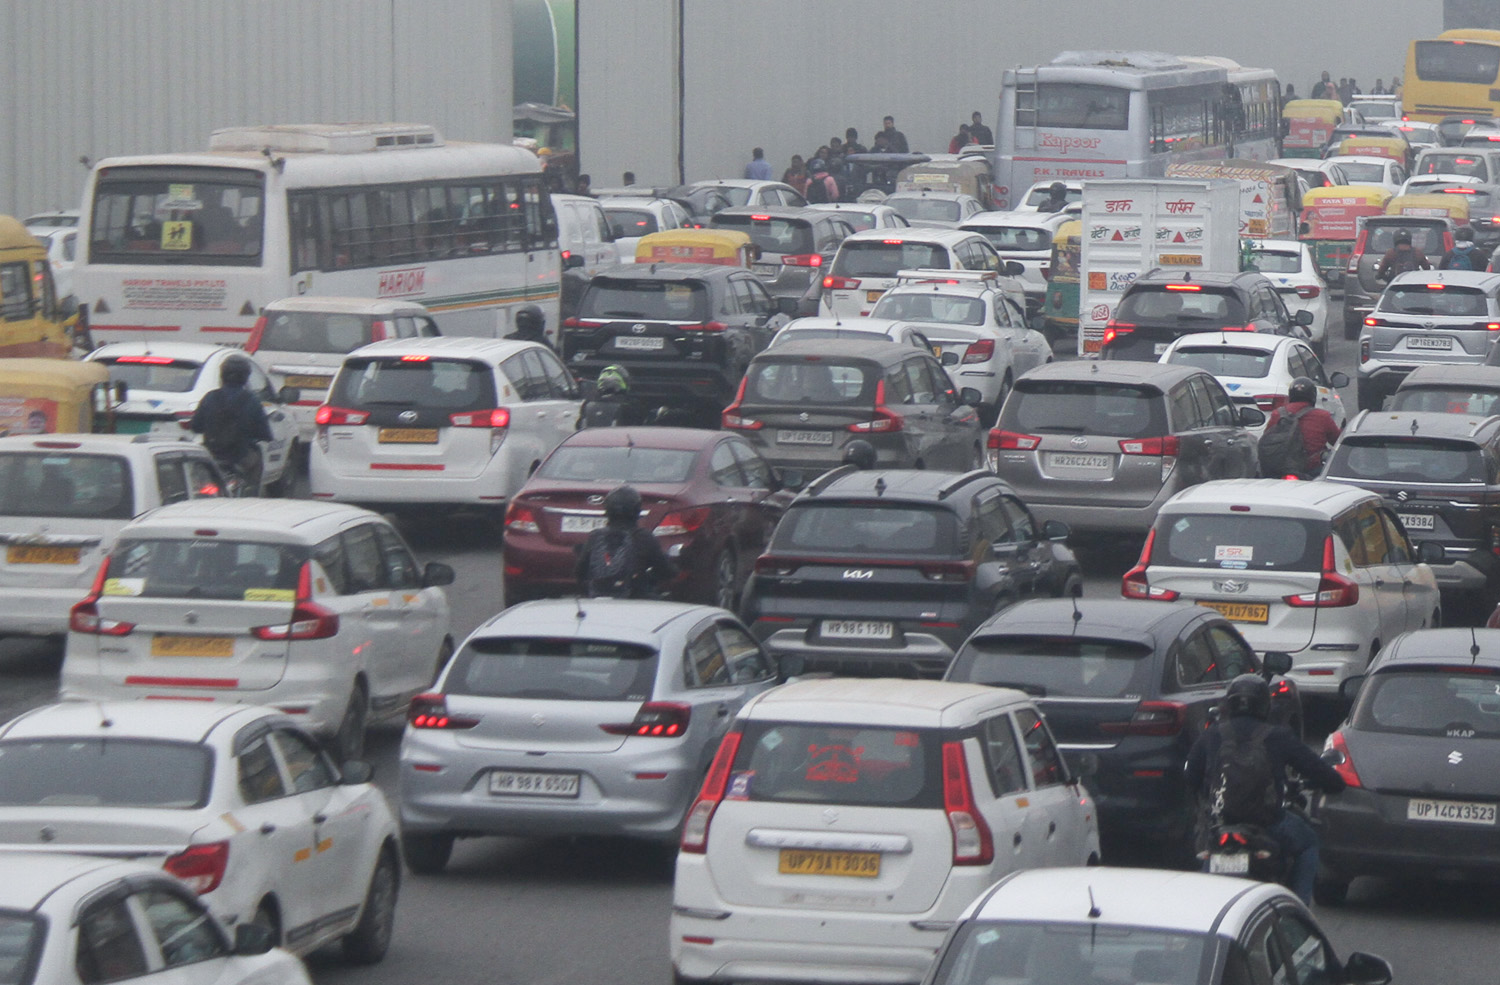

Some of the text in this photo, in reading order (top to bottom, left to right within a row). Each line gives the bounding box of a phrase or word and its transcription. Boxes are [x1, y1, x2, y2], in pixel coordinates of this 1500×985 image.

[1039, 132, 1102, 154] Kapoor
[1056, 168, 1105, 177] TRAVELS
[1104, 199, 1134, 213] डाक
[155, 279, 192, 287] TRAVELS
[379, 270, 425, 295] HARIOM
[1416, 802, 1495, 821] UP14CX3523
